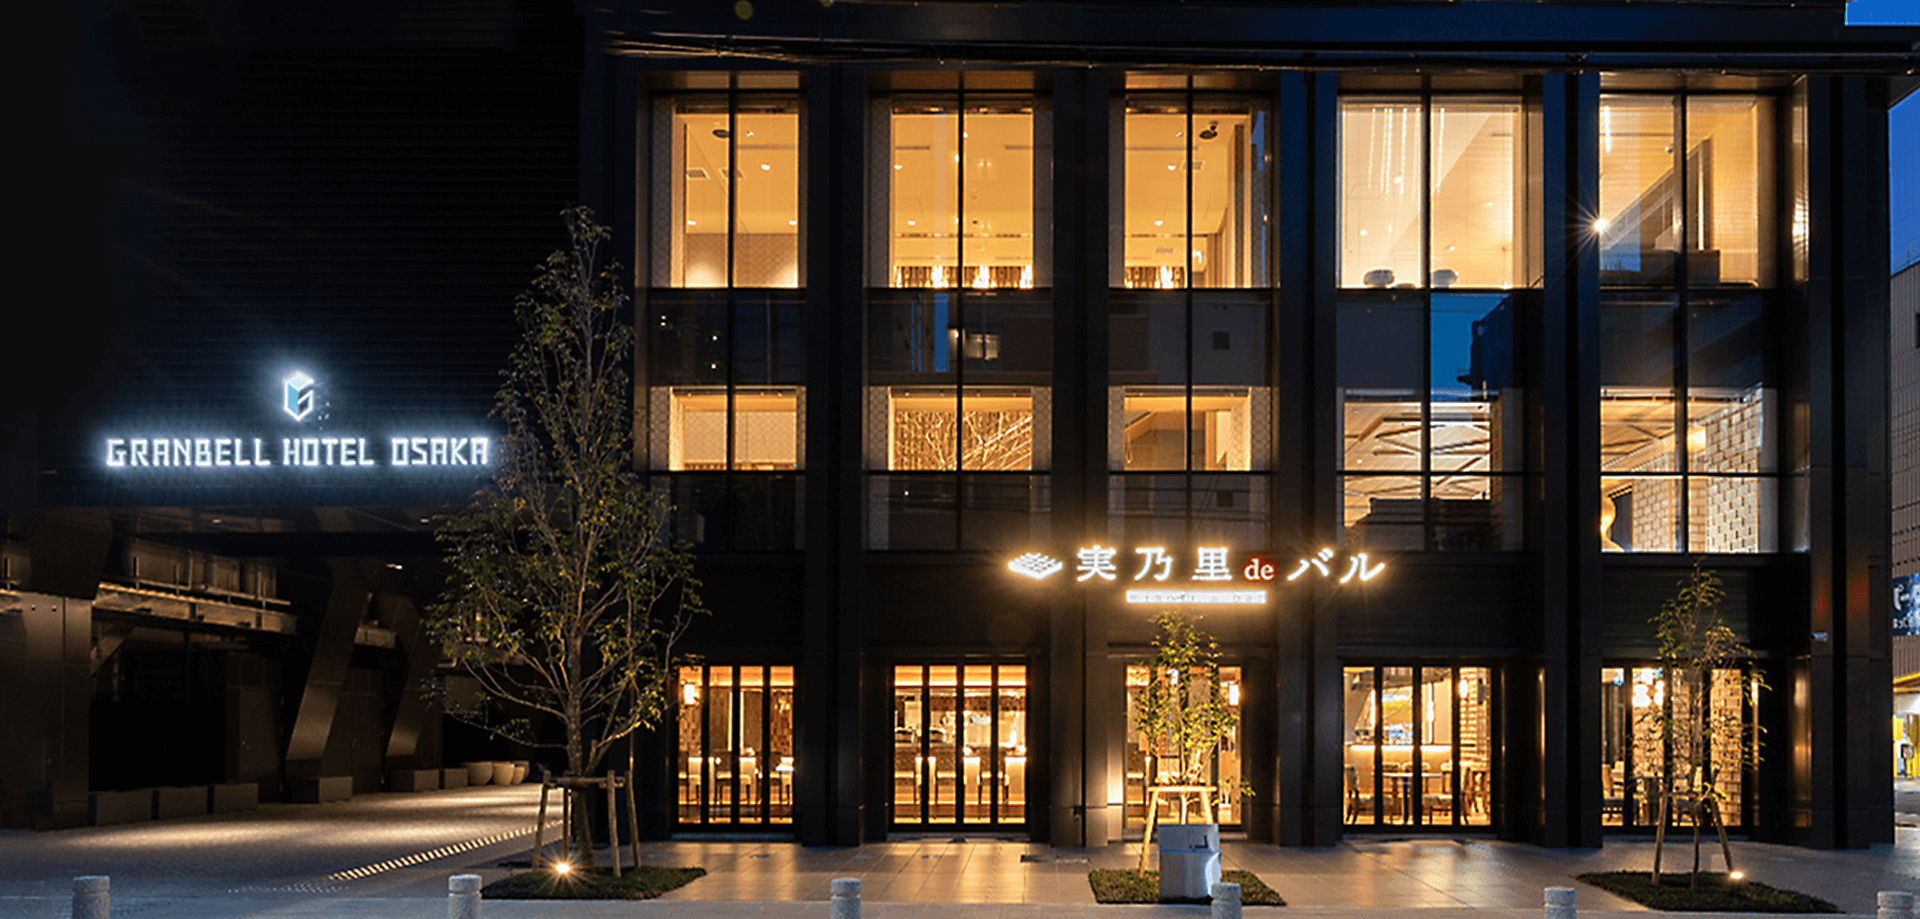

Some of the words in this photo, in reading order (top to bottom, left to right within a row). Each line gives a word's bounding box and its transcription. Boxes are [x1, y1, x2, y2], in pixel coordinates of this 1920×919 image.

[106, 437, 271, 467] GRANBELL
[283, 437, 375, 467] HOTEL
[391, 436, 490, 466] OSAKA
